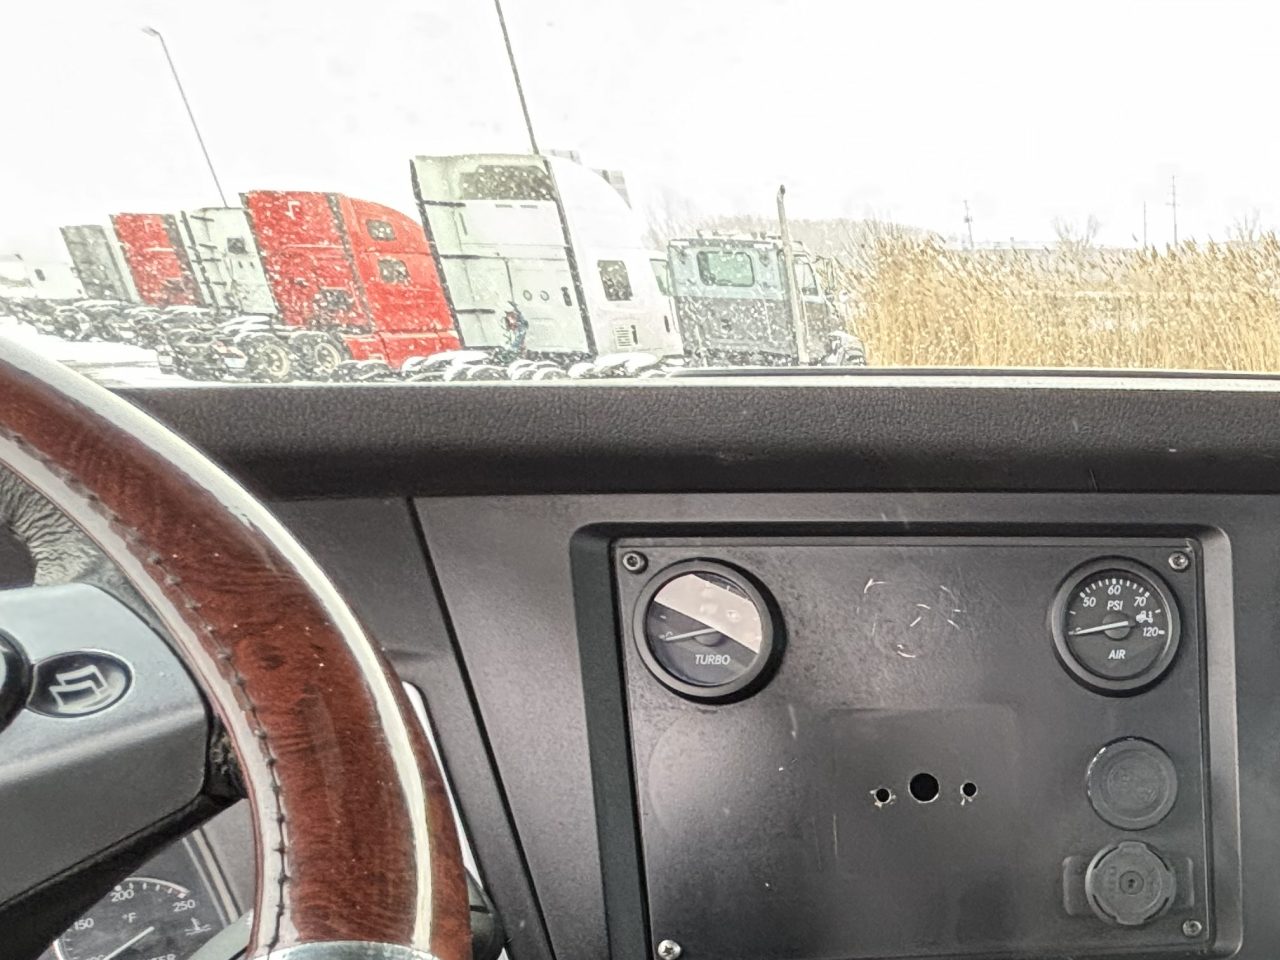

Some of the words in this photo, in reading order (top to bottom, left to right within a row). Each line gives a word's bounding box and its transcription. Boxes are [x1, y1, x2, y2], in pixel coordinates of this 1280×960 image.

[1107, 584, 1121, 595] 60
[1083, 596, 1096, 607] 50
[1106, 600, 1123, 611] PSI
[1133, 596, 1147, 607] 70
[1143, 626, 1159, 637] 120
[695, 654, 731, 665] TURBO
[1108, 649, 1126, 659] AIR
[110, 888, 135, 903] 200
[172, 899, 196, 912] 250
[73, 917, 95, 931] 150
